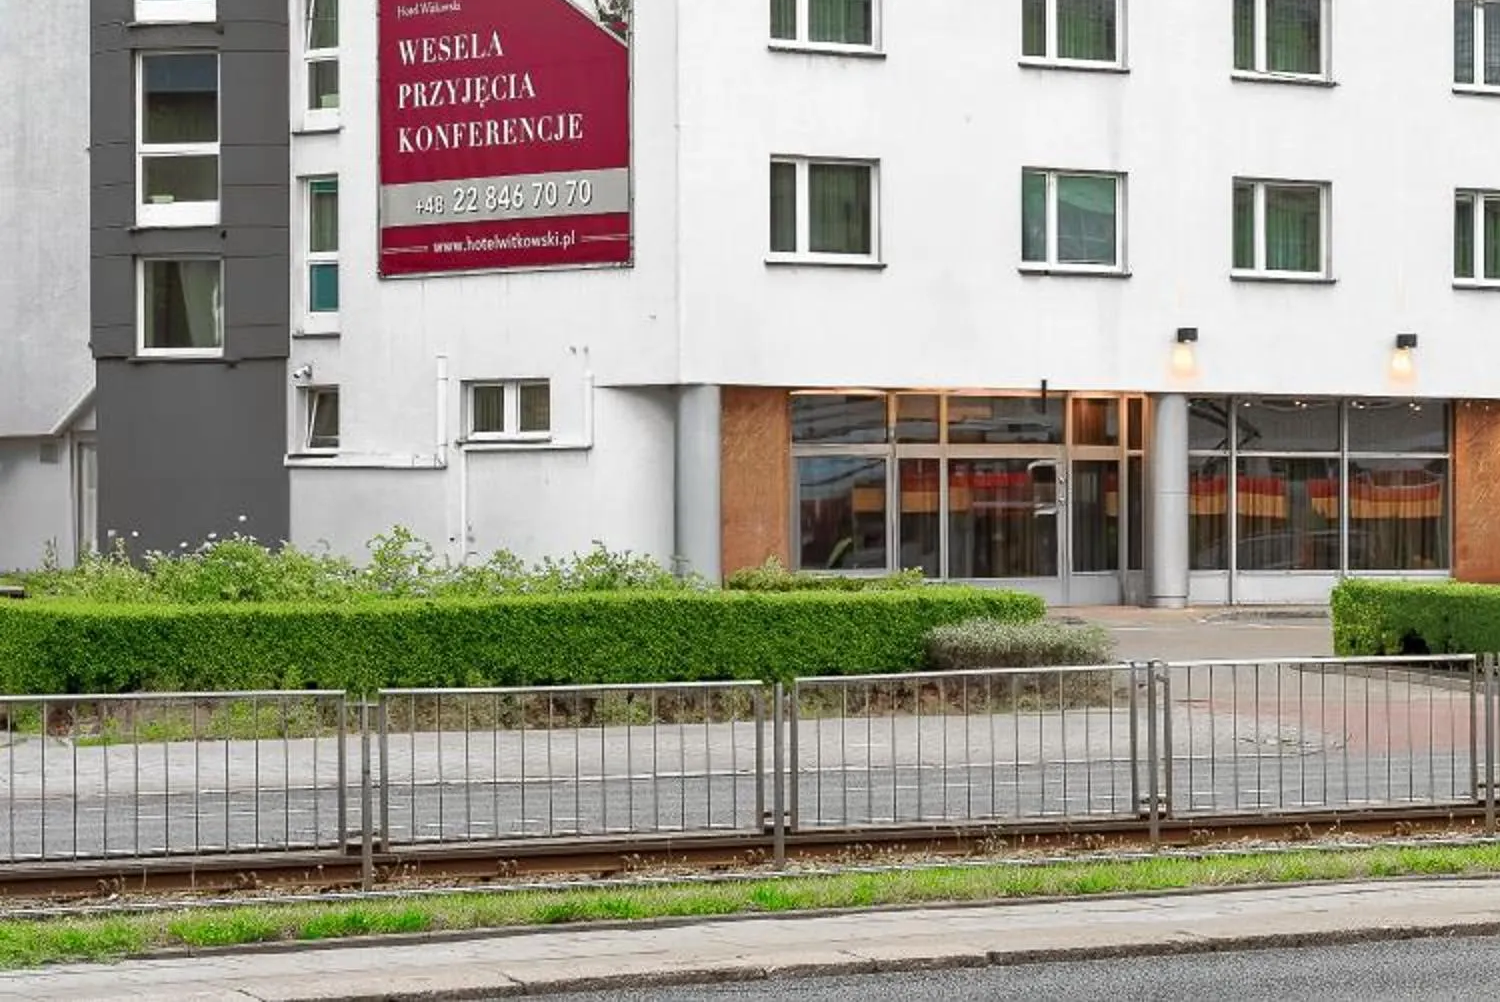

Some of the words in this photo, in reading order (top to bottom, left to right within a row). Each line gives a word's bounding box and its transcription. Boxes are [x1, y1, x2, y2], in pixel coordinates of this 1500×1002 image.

[399, 30, 504, 66] WESELA
[398, 72, 536, 109] PRZYJĘCIA
[399, 113, 584, 153] KONFERENCJE
[415, 195, 445, 215] +48
[453, 187, 479, 213] 22
[485, 184, 525, 210] 846
[532, 181, 558, 207] 70
[566, 179, 592, 205] 70
[433, 230, 576, 254] www.hotelwitkowski.pl
